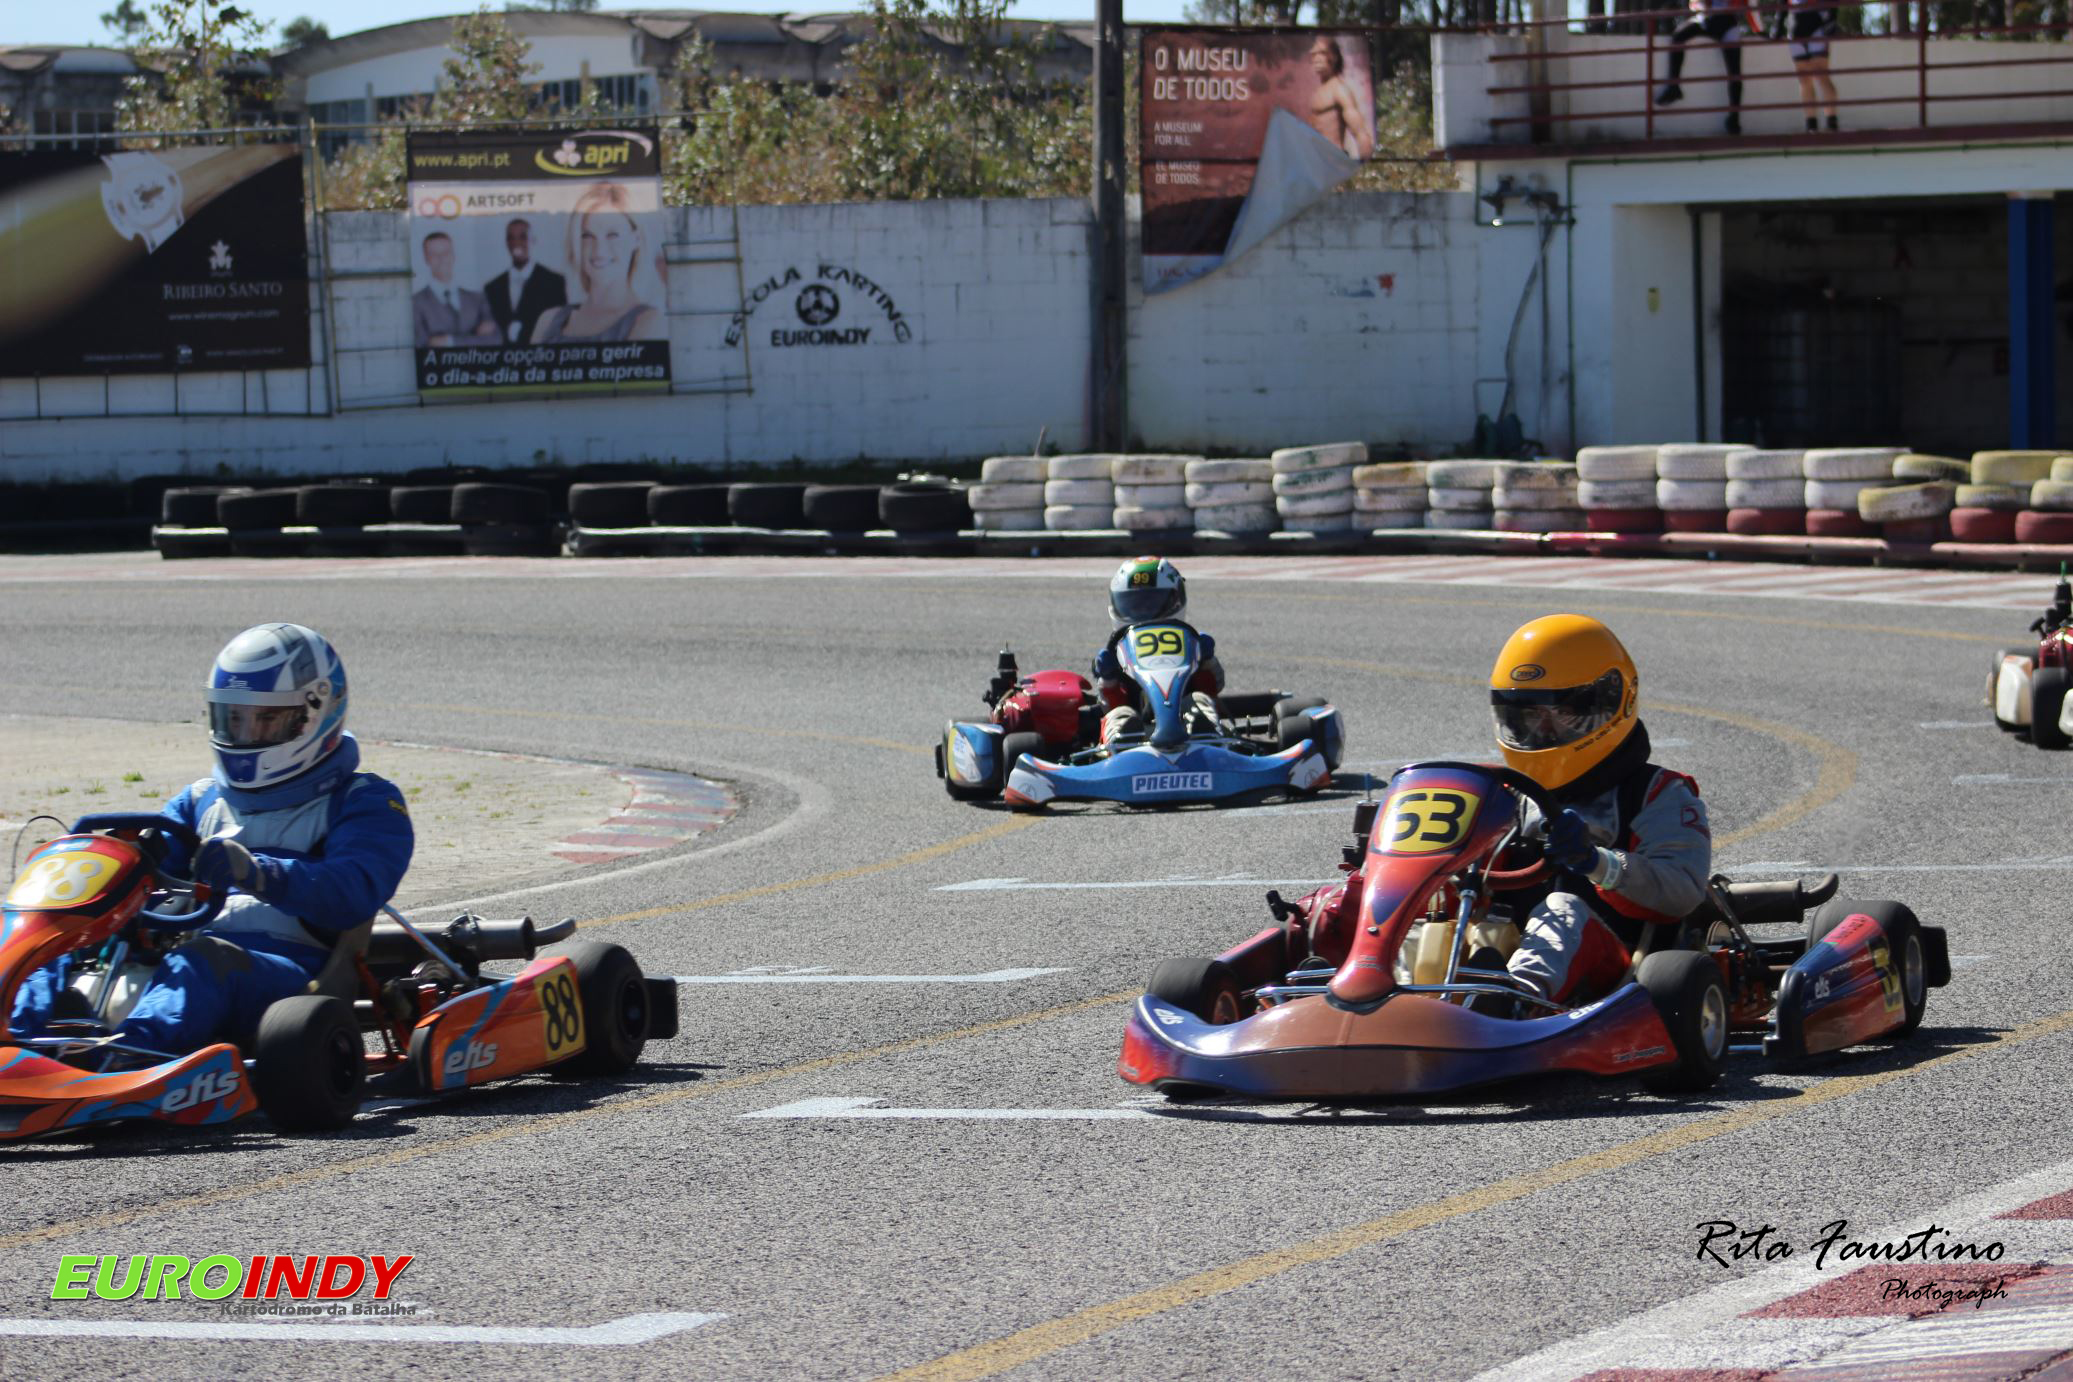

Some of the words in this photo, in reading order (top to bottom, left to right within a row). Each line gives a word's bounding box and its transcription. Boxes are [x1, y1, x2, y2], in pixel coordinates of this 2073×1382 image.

[1154, 47, 1168, 71] O
[1177, 47, 1248, 72] MUSEU
[1153, 77, 1178, 100] DE
[1183, 77, 1249, 100] TODOS
[1153, 121, 1161, 133] A
[1162, 121, 1203, 133] MUSEUM
[1154, 134, 1172, 146] FOR
[1174, 134, 1191, 146] ALL
[413, 152, 511, 169] www.apri.pt
[583, 140, 630, 168] apri
[1155, 173, 1168, 184] DE
[1170, 173, 1201, 184] TODOS
[466, 193, 536, 208] ARTSOFT
[724, 266, 801, 348] ESCOLA
[817, 264, 912, 344] KARTING
[770, 328, 871, 347] EUROINDY
[424, 351, 438, 366] A
[441, 349, 499, 365] melhor
[503, 347, 553, 367] opção
[559, 349, 597, 365] para
[601, 343, 644, 364] gerir
[425, 371, 437, 386] o
[442, 367, 520, 386] dia-a-dia
[524, 366, 546, 383] da
[551, 368, 583, 382] sua
[588, 364, 665, 382] empresa
[1133, 573, 1150, 584] 99
[1135, 630, 1183, 658] 99
[1133, 773, 1212, 792] PNEUTEC
[1388, 792, 1467, 844] 63
[13, 857, 103, 906] 88
[541, 973, 580, 1051] 88
